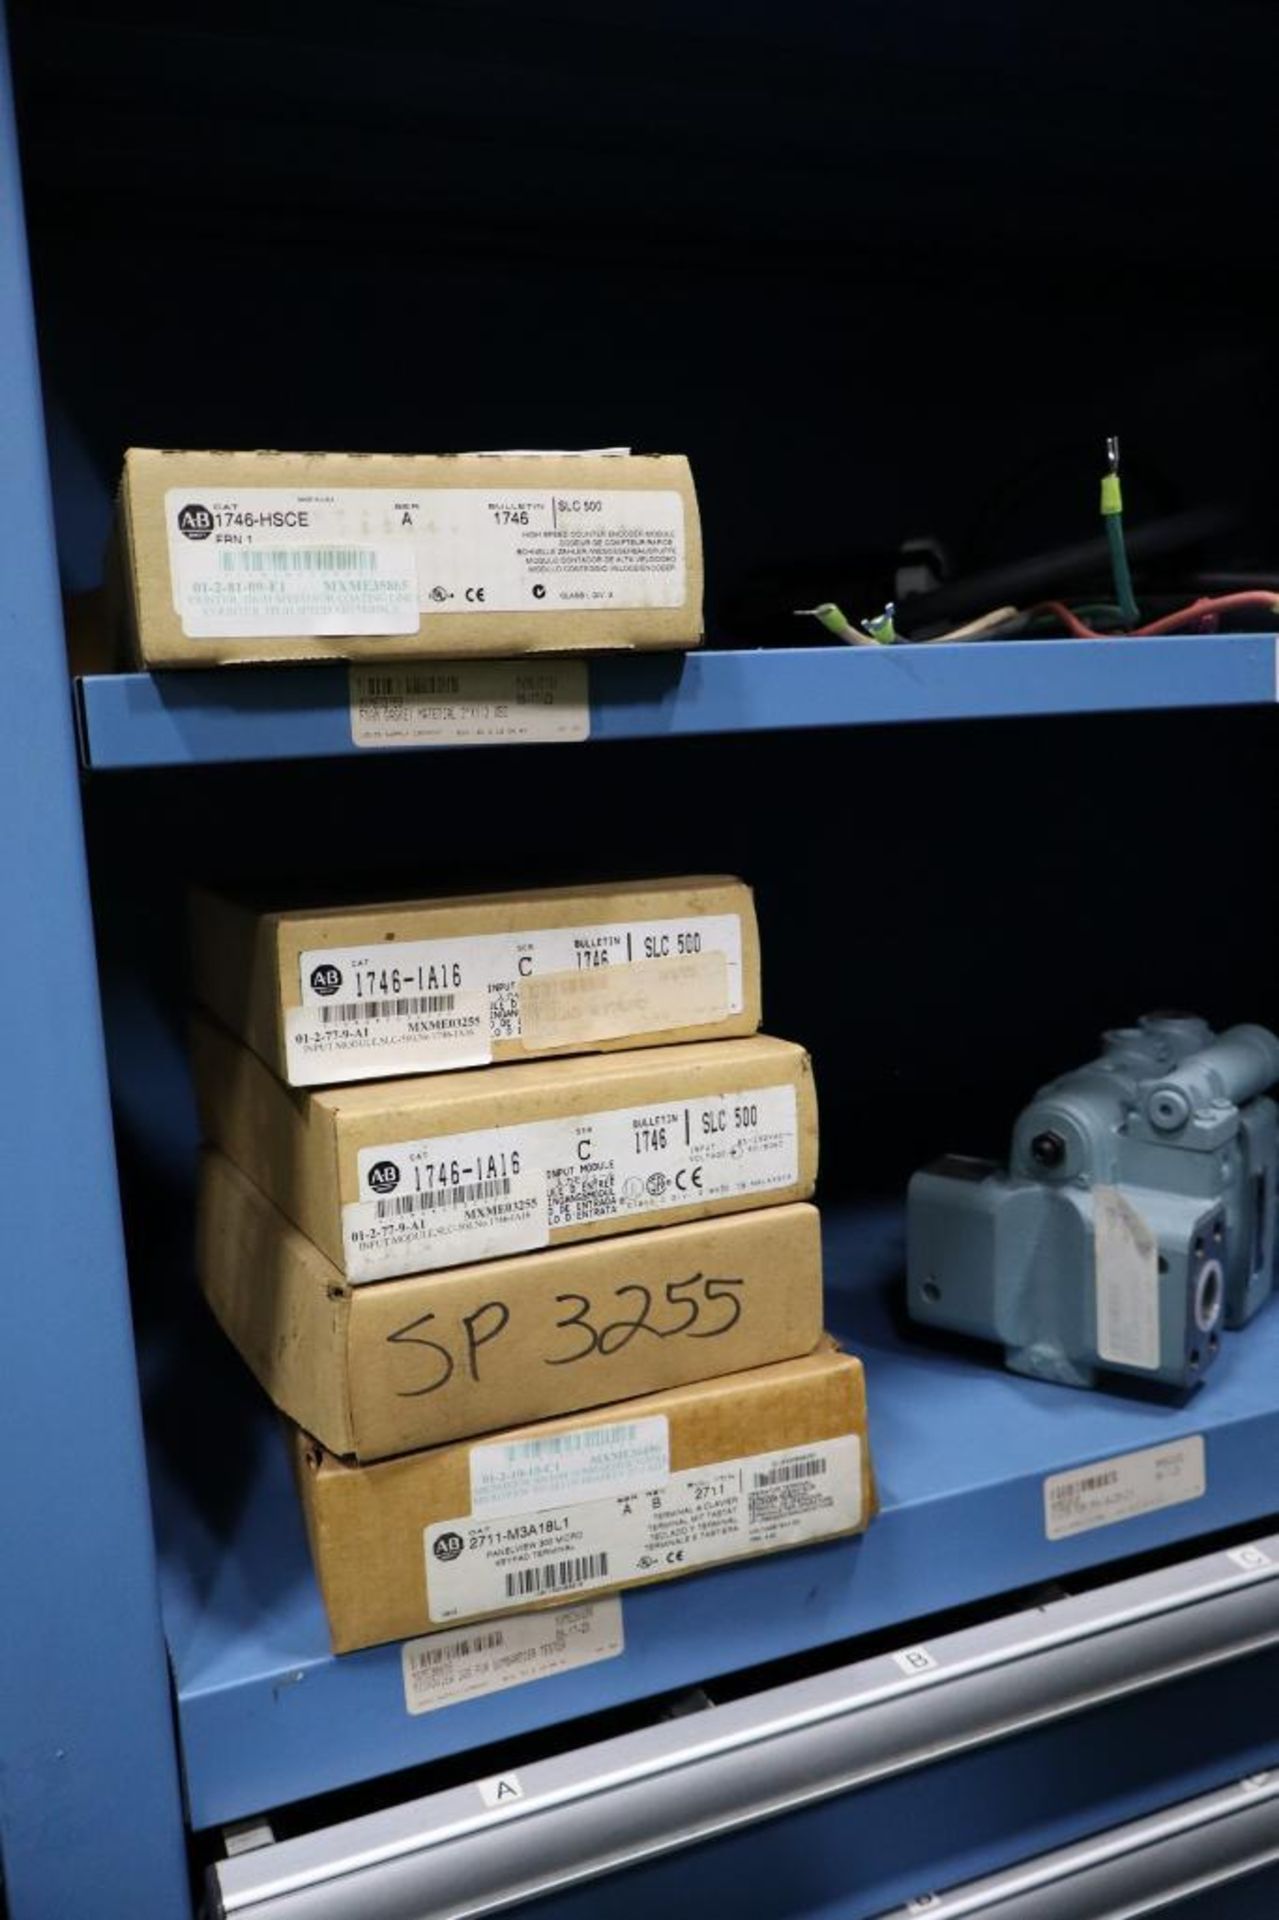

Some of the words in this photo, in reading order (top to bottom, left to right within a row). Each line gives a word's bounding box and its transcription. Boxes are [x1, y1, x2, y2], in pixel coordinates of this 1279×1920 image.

[557, 501, 581, 512] SLC
[583, 501, 602, 512] 500
[215, 512, 309, 528] 1746-HSCE
[401, 511, 413, 526] A
[494, 512, 529, 526] 1746
[574, 937, 621, 949] BULLETIN
[643, 936, 670, 958] SLC
[677, 932, 702, 955] 500
[518, 957, 533, 977] C
[632, 1114, 679, 1128] BULLETIN
[701, 1111, 726, 1135] SLC
[734, 1104, 758, 1128] 500
[635, 1127, 667, 1154] 1746
[577, 1139, 592, 1160] C
[580, 1160, 614, 1174] MODULE
[351, 1219, 426, 1242] 01-2-77-9-A1
[386, 1300, 510, 1397] SP
[544, 1272, 745, 1366] 3255
[694, 1484, 725, 1499] 2711
[622, 1503, 633, 1515] A
[651, 1497, 662, 1510] B
[469, 1517, 570, 1550] 2711-M3A18L1
[906, 1650, 929, 1668] B
[496, 1780, 518, 1799] A
